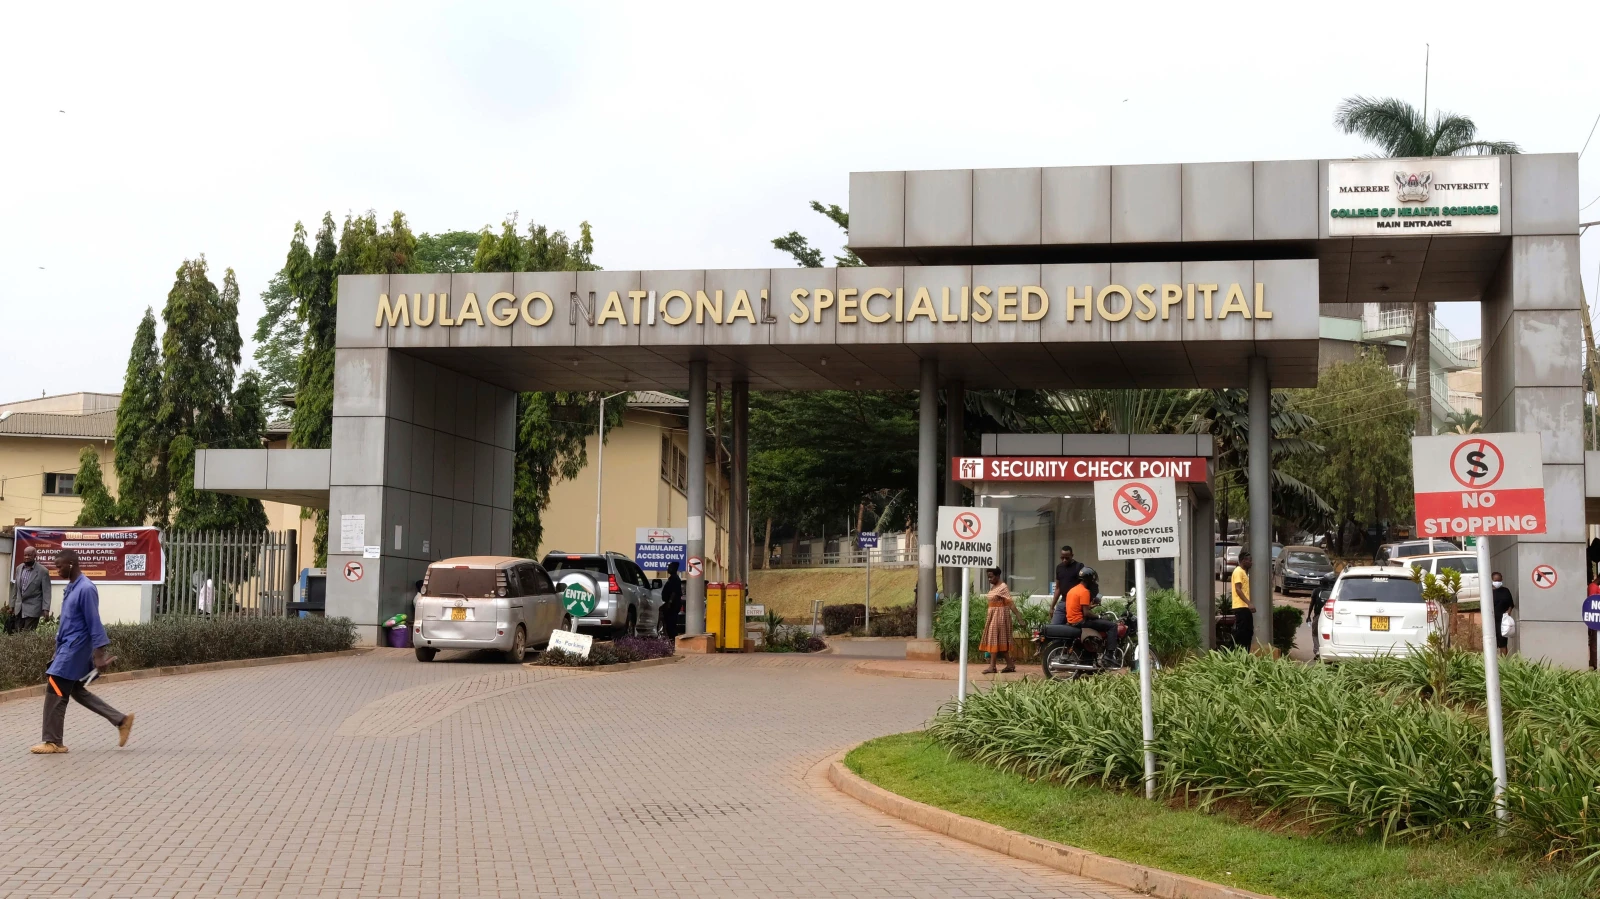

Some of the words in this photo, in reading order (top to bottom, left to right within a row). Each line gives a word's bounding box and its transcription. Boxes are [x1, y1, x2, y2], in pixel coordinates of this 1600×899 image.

[1339, 185, 1390, 193] MAKERERE
[1434, 182, 1490, 191] UNIVERSITY
[1330, 208, 1379, 218] COLLEGE
[1381, 207, 1395, 217] OF
[1398, 206, 1440, 217] HEALTH
[1442, 205, 1499, 216] SCIENCES
[1403, 220, 1452, 228] ENTRANCE
[375, 291, 554, 327] MULAGO
[569, 288, 777, 326] NATIONAL
[788, 285, 1050, 324] SPECIALISED
[1067, 282, 1273, 322] HOSPITAL
[991, 461, 1068, 478] SECURITY
[1073, 461, 1134, 478] CHECK
[1140, 461, 1192, 478] POINT
[1461, 492, 1496, 509] NO
[1424, 514, 1538, 534] STOPPING
[100, 532, 138, 540] CONGRESS
[1114, 526, 1174, 537] MOTORCYCLES
[940, 540, 953, 550] NO
[954, 541, 992, 552] PARKING
[1102, 538, 1140, 546] ALLOWED
[1141, 536, 1174, 544] BEYOND
[1136, 546, 1160, 554] POINT
[938, 554, 951, 564] NO
[951, 554, 993, 567] STOPPING
[565, 588, 592, 602] ENTRY
